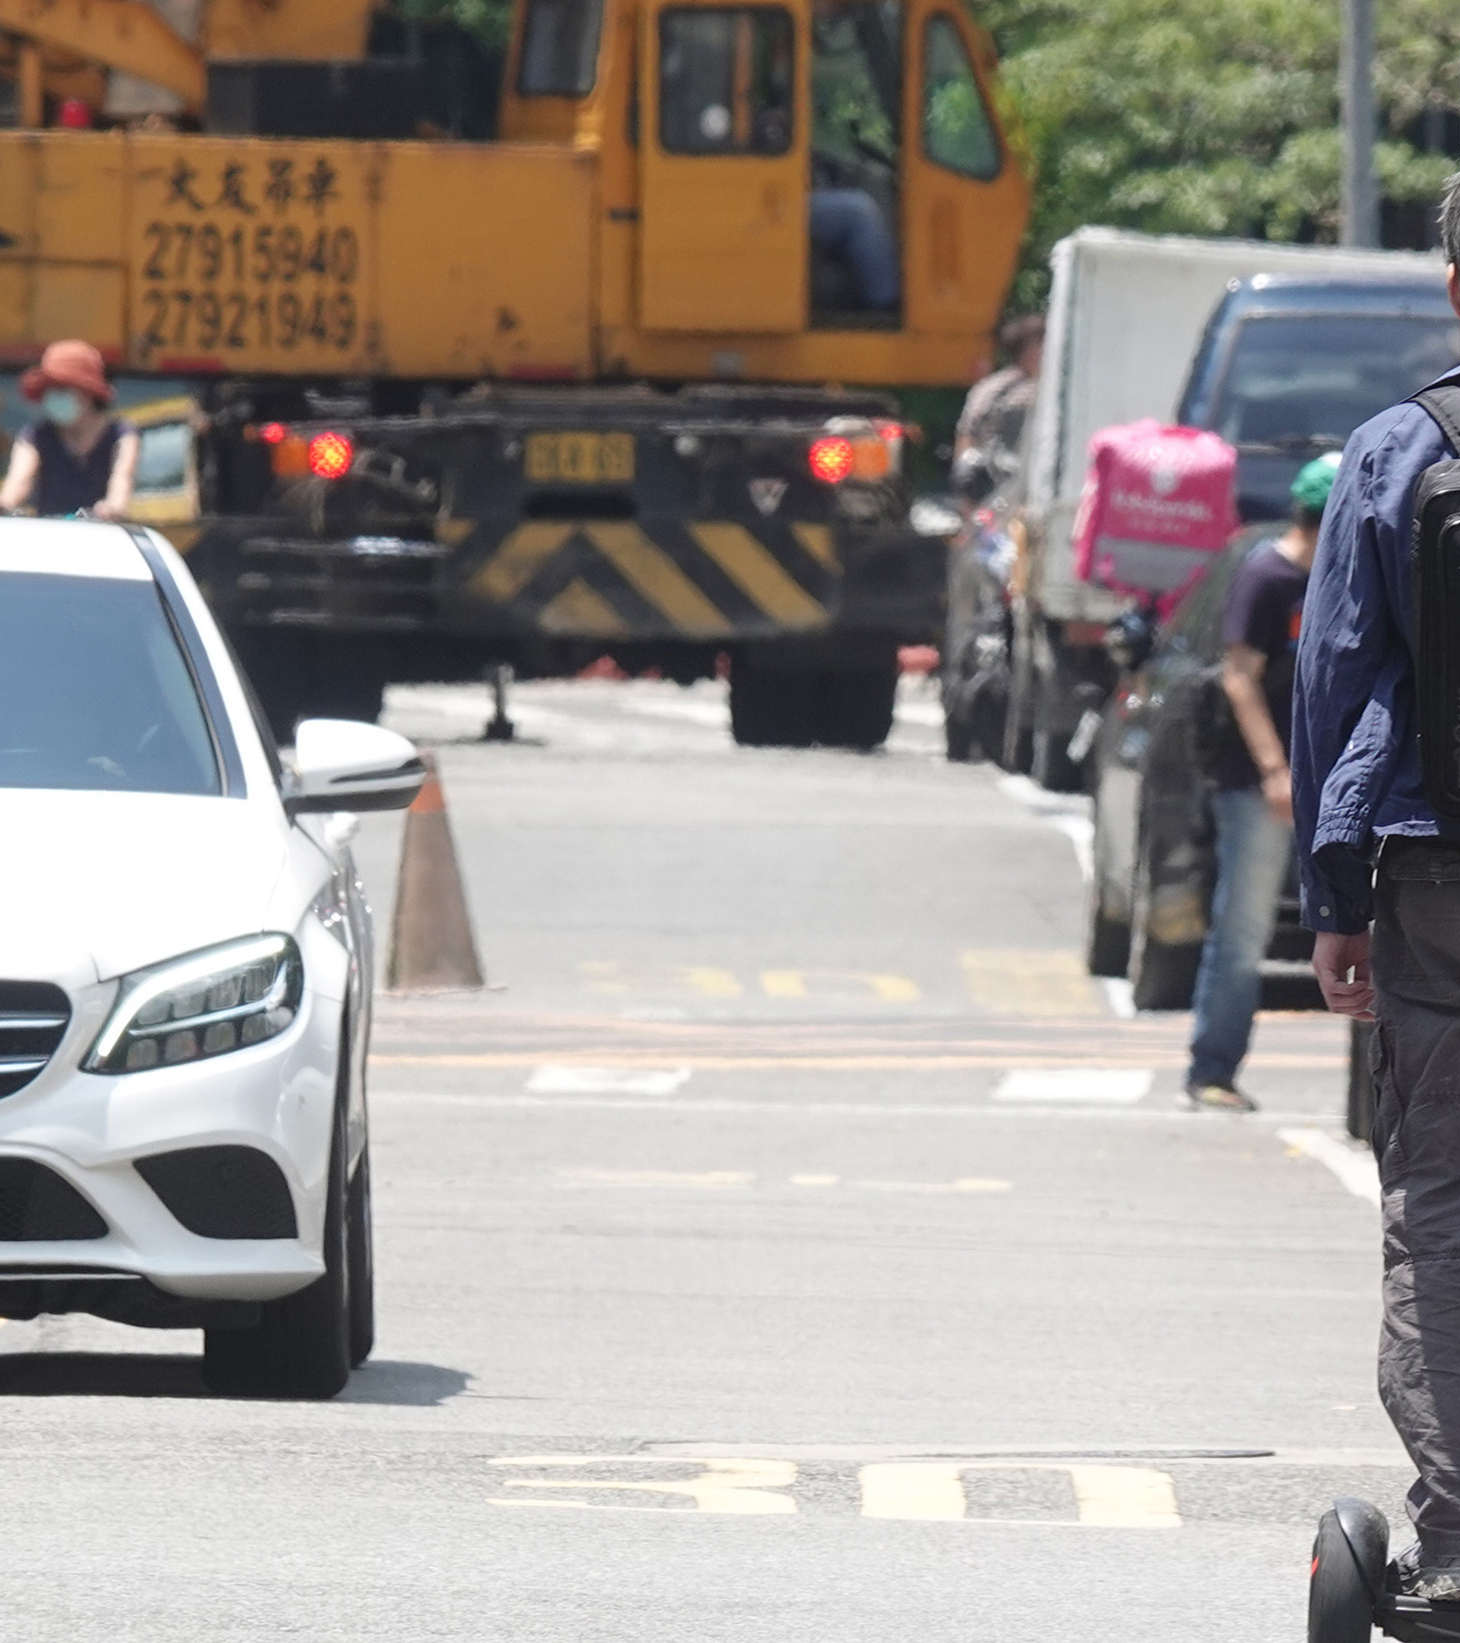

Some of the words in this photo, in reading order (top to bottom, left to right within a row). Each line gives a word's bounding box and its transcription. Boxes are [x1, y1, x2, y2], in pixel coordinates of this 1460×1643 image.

[143, 221, 360, 285] 27915940
[141, 288, 358, 350] 27921949
[485, 1456, 1183, 1528] 30
